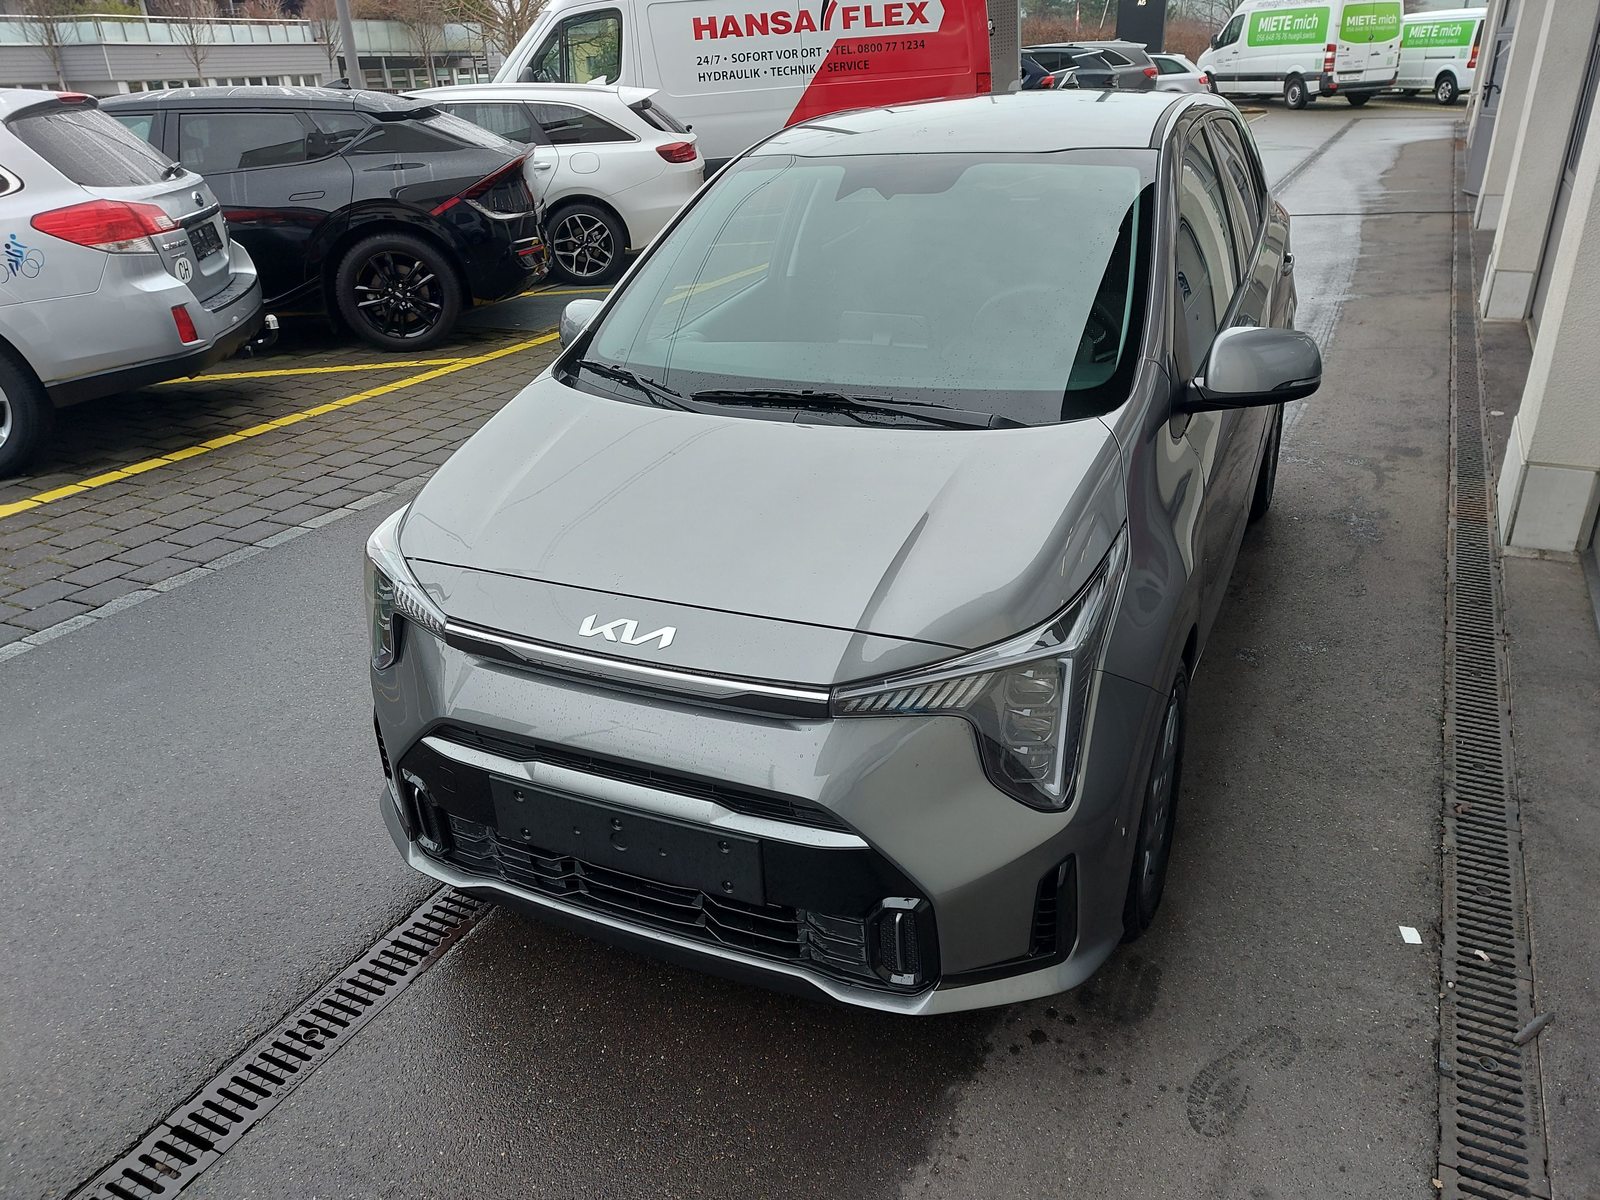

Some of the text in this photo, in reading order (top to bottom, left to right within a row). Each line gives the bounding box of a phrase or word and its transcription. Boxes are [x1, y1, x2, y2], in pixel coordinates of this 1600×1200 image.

[692, 1, 930, 41] HANSA FLEX
[1258, 13, 1319, 32] MIETE mich
[1346, 14, 1397, 27] MIETE mich
[1409, 24, 1440, 38] MIETE
[1439, 24, 1462, 37] mich
[696, 39, 925, 66] 24/7 SOFORT VOR ORT TEL. 0800 77 1234
[698, 60, 870, 82] HYDRAULIK TECHNIK SERVICE
[179, 260, 191, 280] CH
[578, 613, 677, 650] KIA
